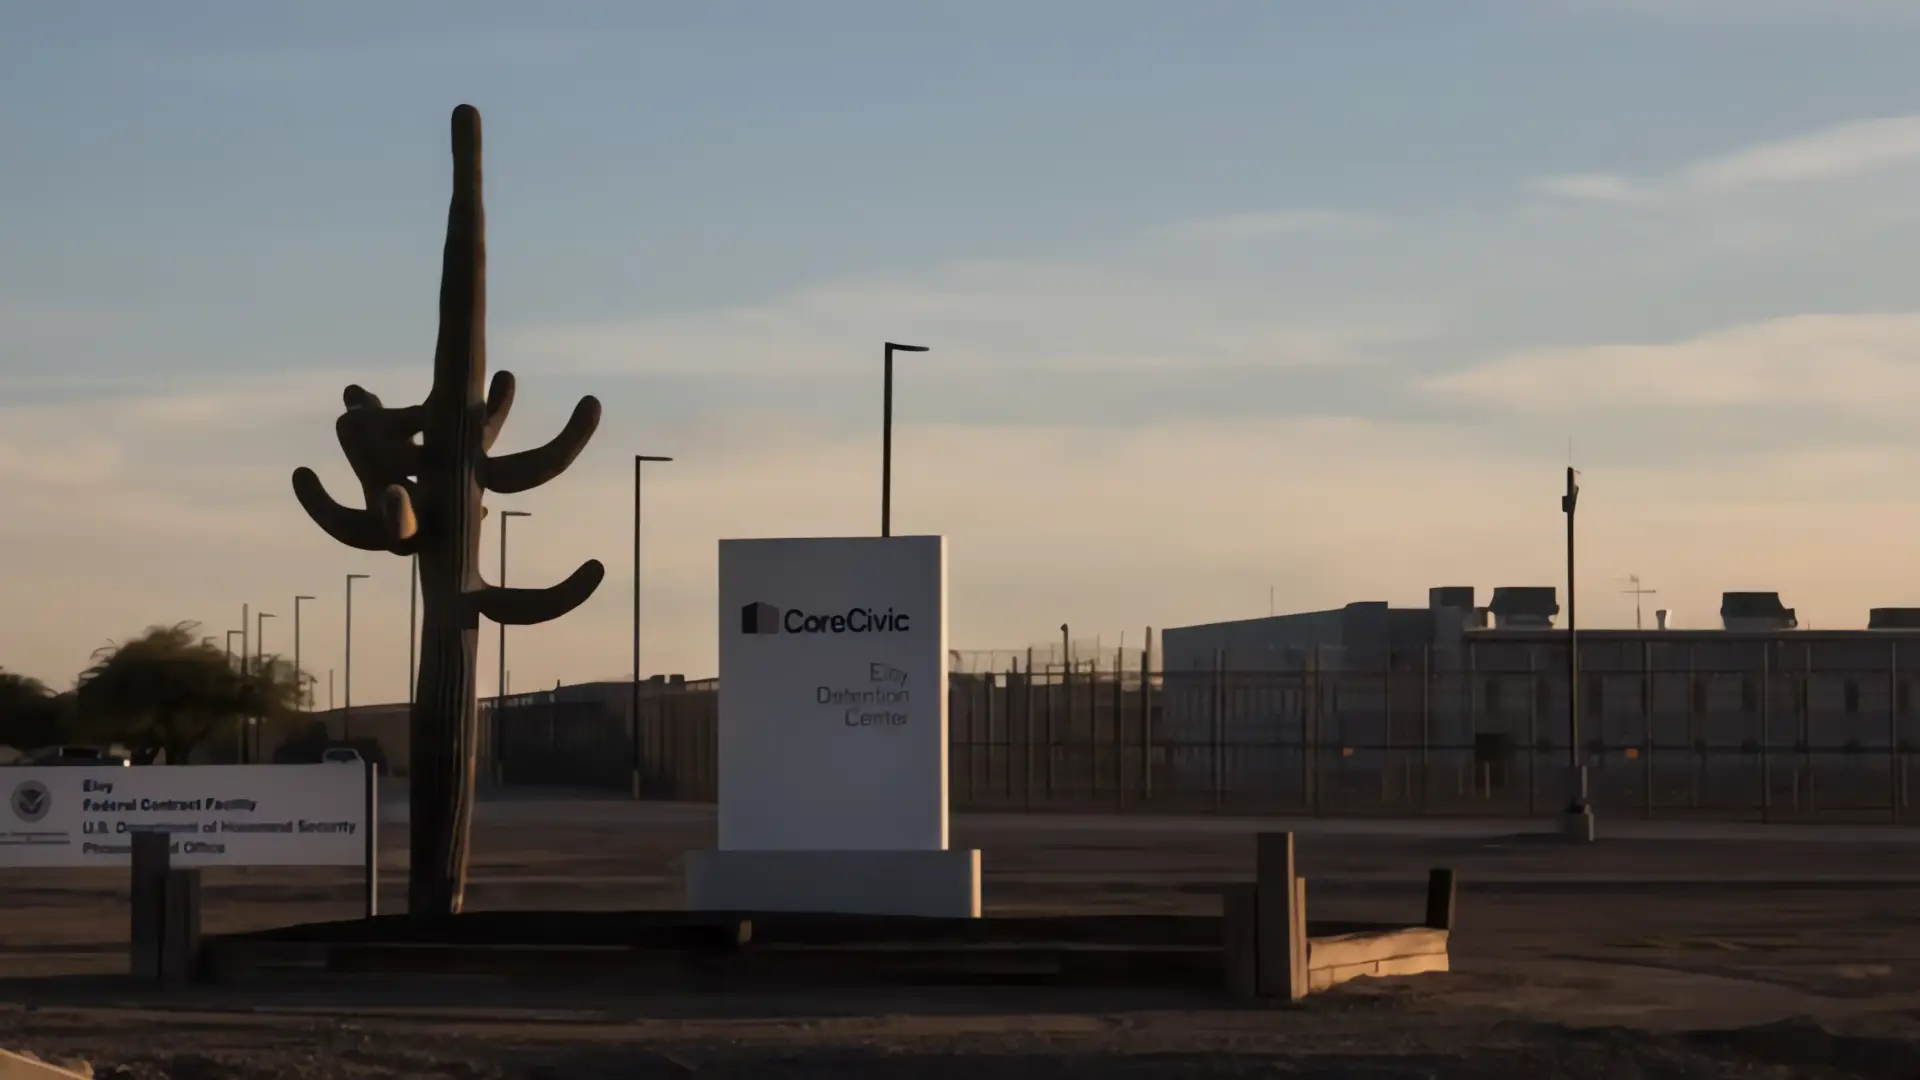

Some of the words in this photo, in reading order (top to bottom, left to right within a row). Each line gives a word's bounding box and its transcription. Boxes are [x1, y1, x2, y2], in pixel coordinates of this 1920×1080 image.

[784, 608, 910, 633] CoreCivic
[817, 686, 909, 705] Detention
[845, 708, 908, 727] Center
[83, 798, 137, 811] Federal
[141, 798, 201, 811] Contract
[205, 797, 257, 812] Facy
[203, 820, 218, 833] of
[298, 819, 356, 834] Security
